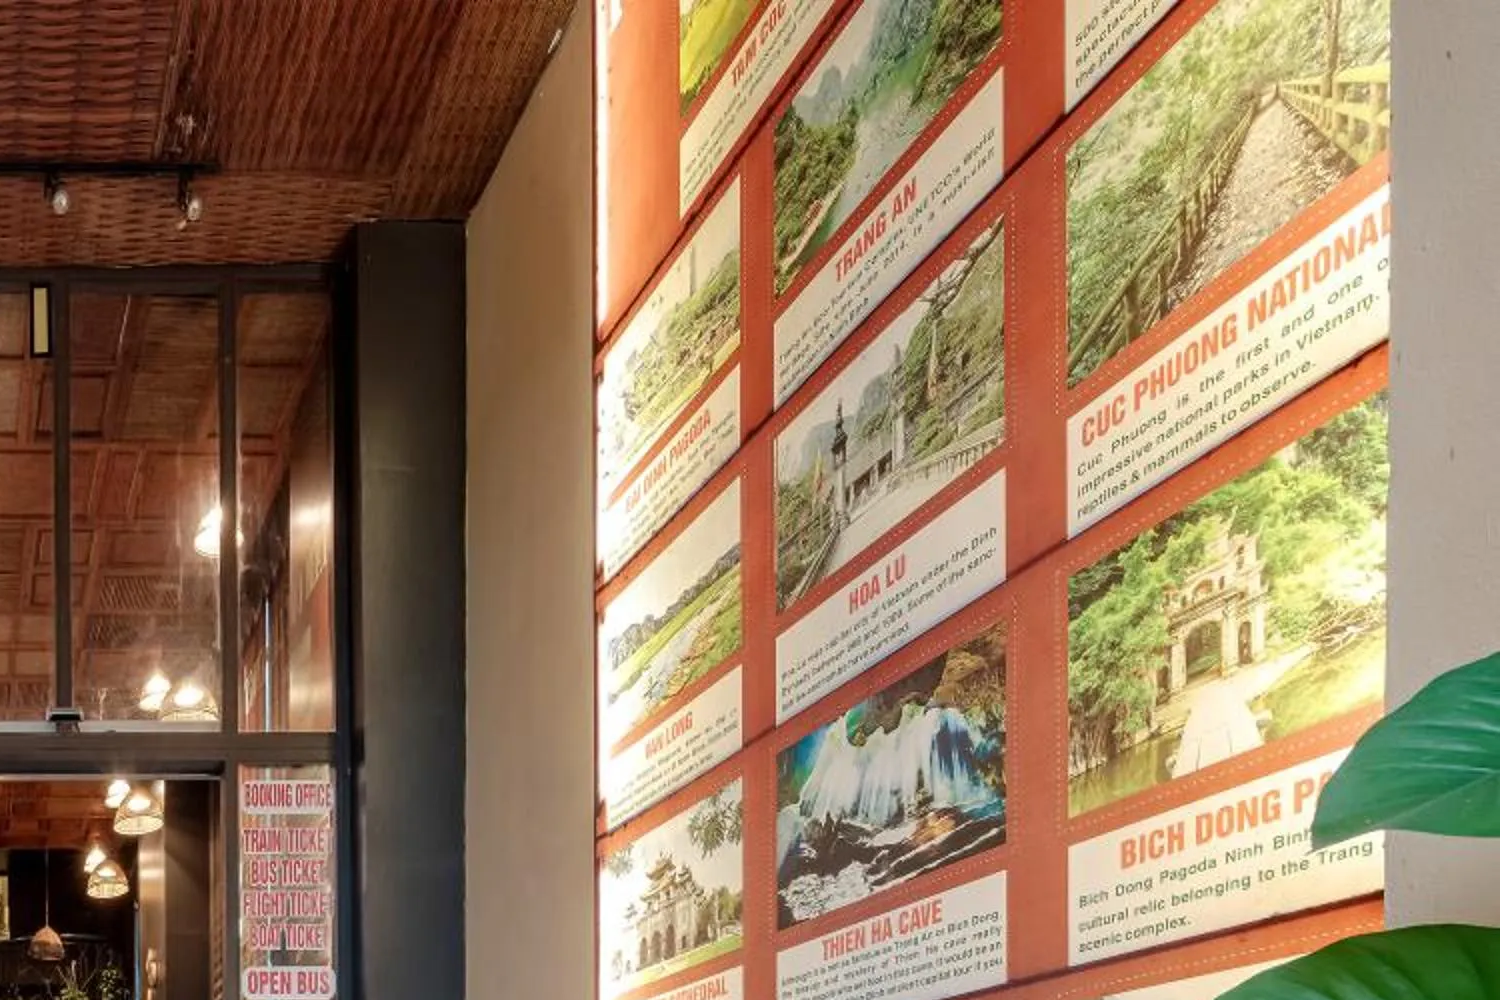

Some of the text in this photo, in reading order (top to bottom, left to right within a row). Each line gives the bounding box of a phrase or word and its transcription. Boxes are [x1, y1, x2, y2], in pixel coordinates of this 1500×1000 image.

[836, 178, 915, 280] TRANG AN
[1077, 452, 1102, 476] Cuc
[1111, 410, 1166, 454] Phuong
[1176, 393, 1188, 409] is
[1199, 369, 1225, 393] the
[1235, 337, 1269, 368] first
[1281, 304, 1314, 338] and
[1327, 275, 1363, 305] one
[1082, 395, 1124, 446] CUC
[1134, 316, 1236, 410] PHUONG
[1156, 395, 1218, 444] national
[1222, 363, 1268, 403] parks
[1274, 349, 1290, 367] in
[1296, 294, 1379, 350] Vietnam.
[1077, 361, 1314, 519] reptiles & mammals to observe.
[849, 554, 905, 613] HOA LU
[245, 783, 331, 807] BOOKING OFFICE
[243, 829, 280, 852] TRAIN
[1120, 823, 1184, 868] BICH
[1195, 791, 1280, 844] DONG
[243, 891, 284, 916] FLIGHT
[252, 861, 325, 884] BUS TICKET
[1078, 841, 1372, 932] cultural relic belonging to the Trang
[1079, 890, 1108, 908] Bich
[1115, 877, 1152, 897] Dong
[1159, 858, 1216, 884] Pagoda
[1224, 843, 1263, 864] Ninh
[823, 900, 942, 960] THIEN HA CAVE
[1078, 916, 1190, 953] scenic complex.
[247, 971, 330, 994] OPEN BUS
